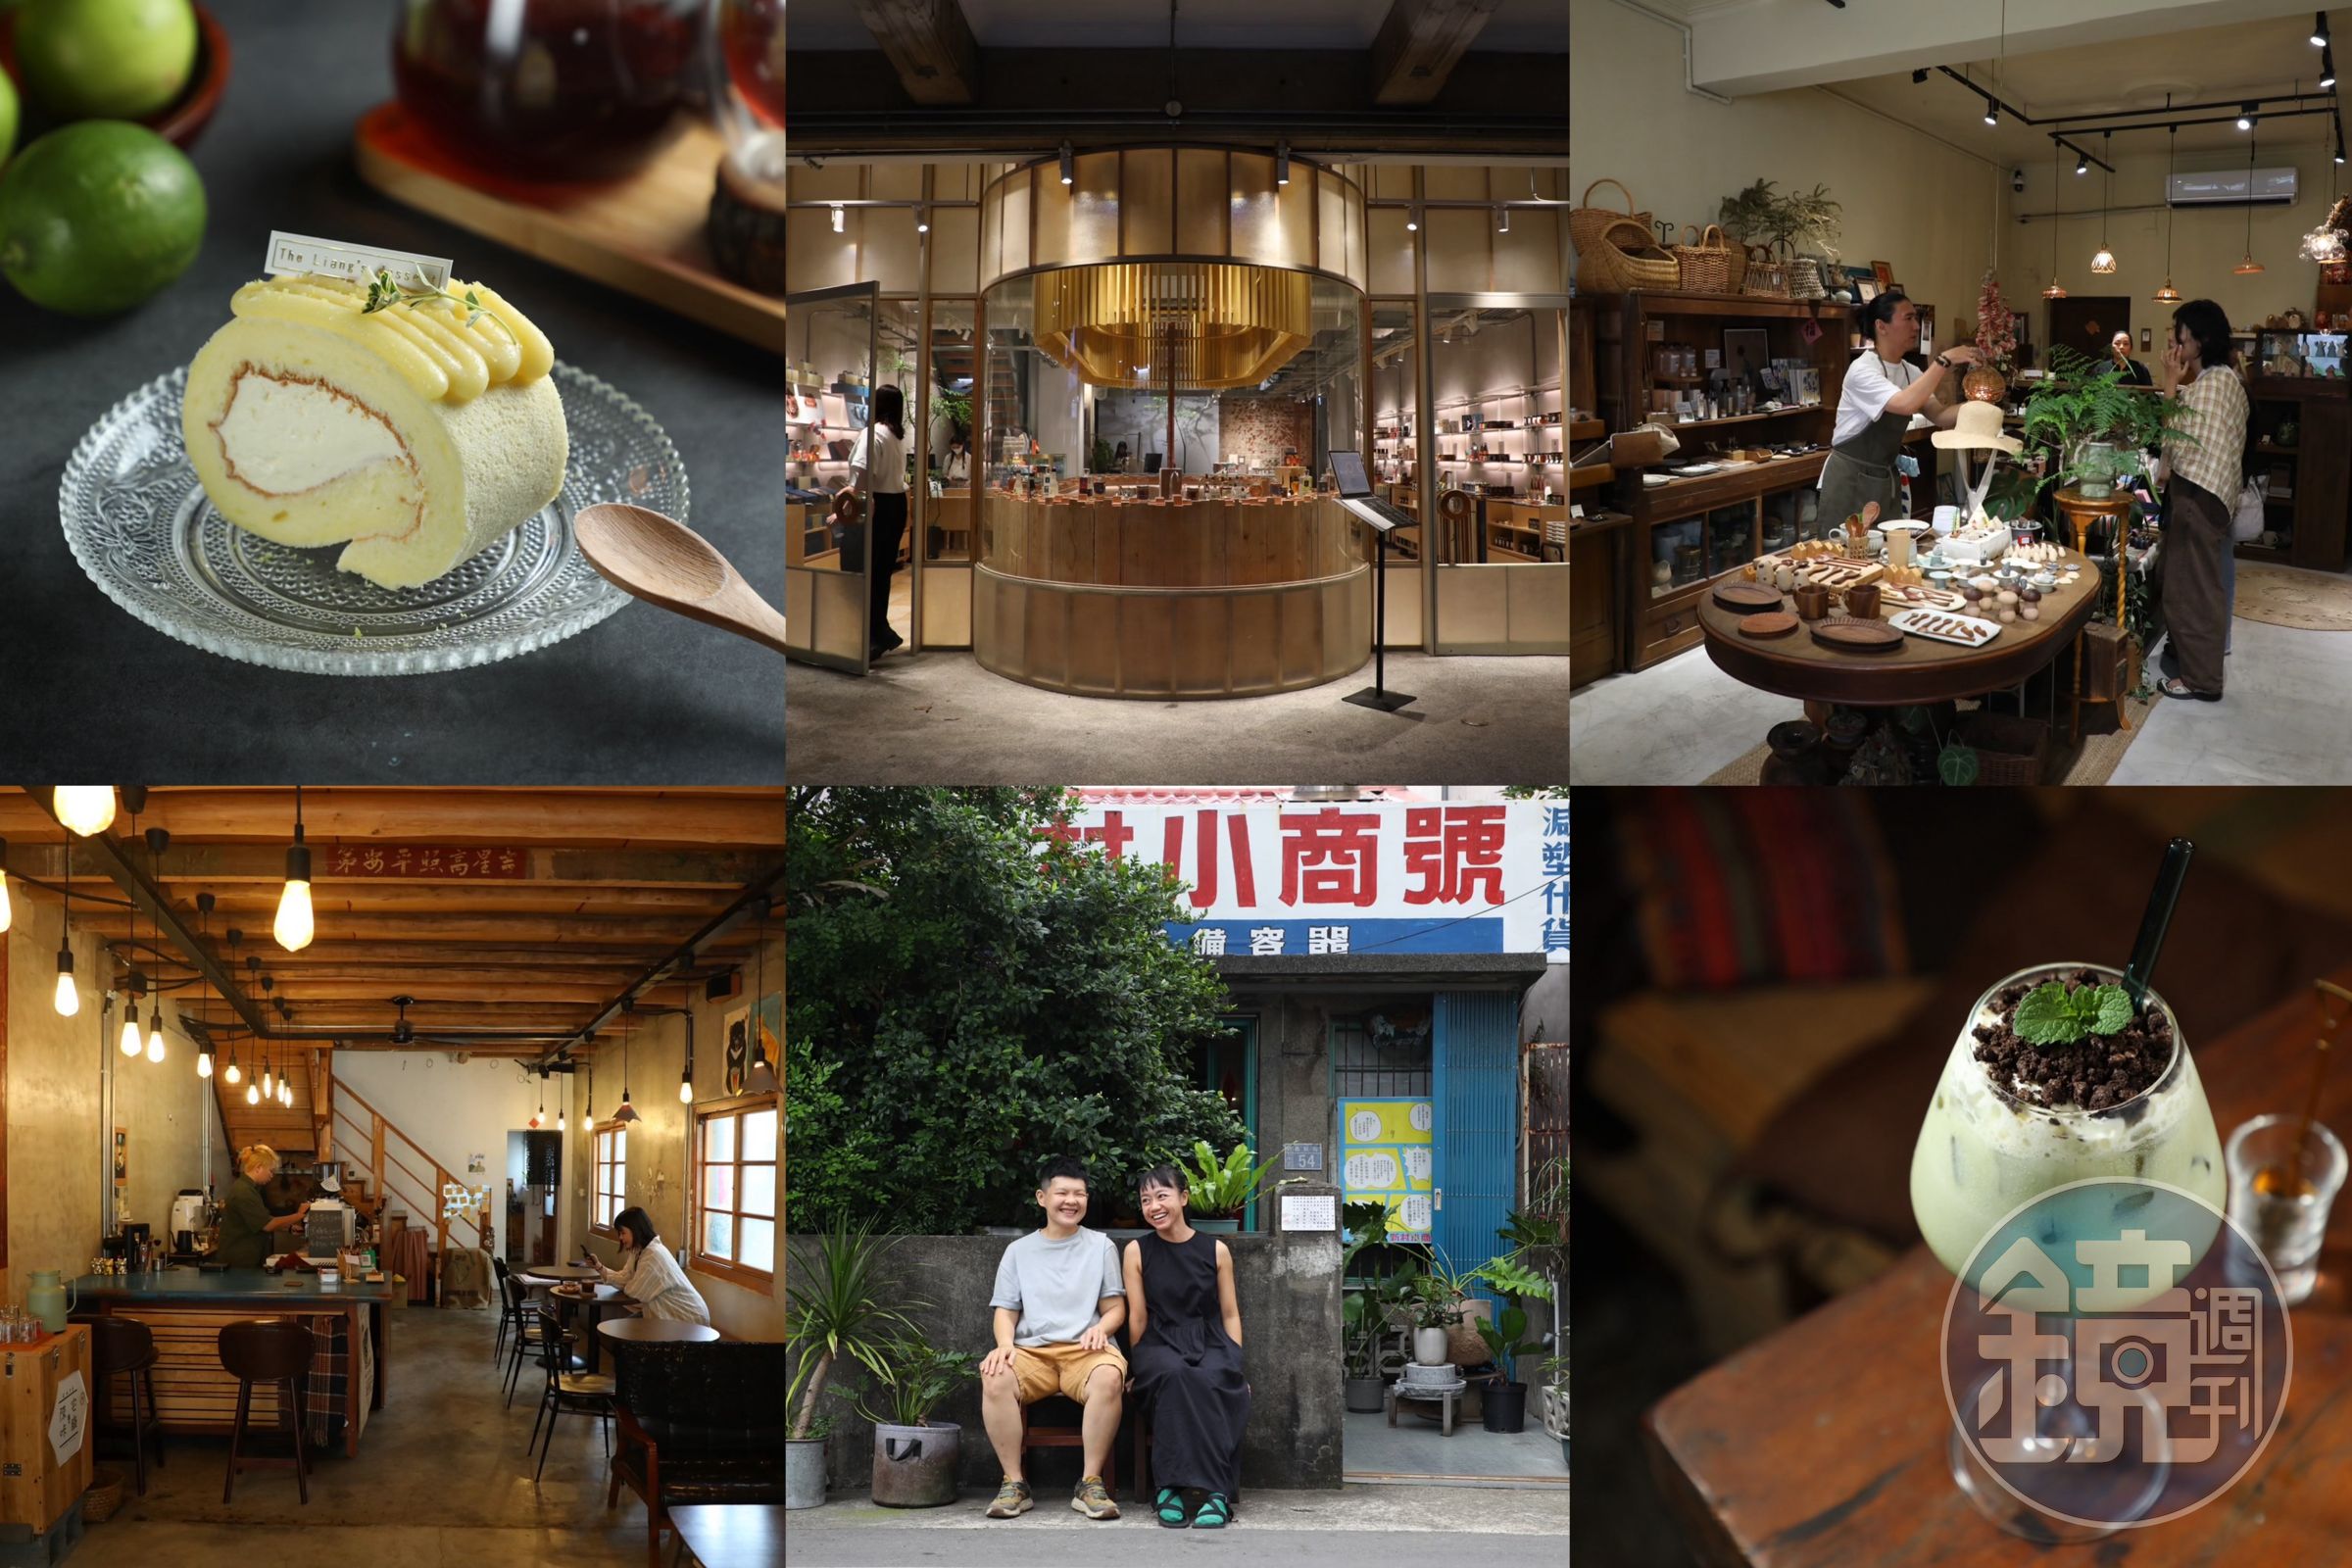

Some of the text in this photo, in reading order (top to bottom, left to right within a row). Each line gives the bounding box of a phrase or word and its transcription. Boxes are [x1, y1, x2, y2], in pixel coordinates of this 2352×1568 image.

[280, 247, 303, 264] The
[313, 253, 368, 273] Liang's
[1298, 1153, 1316, 1168] 54
